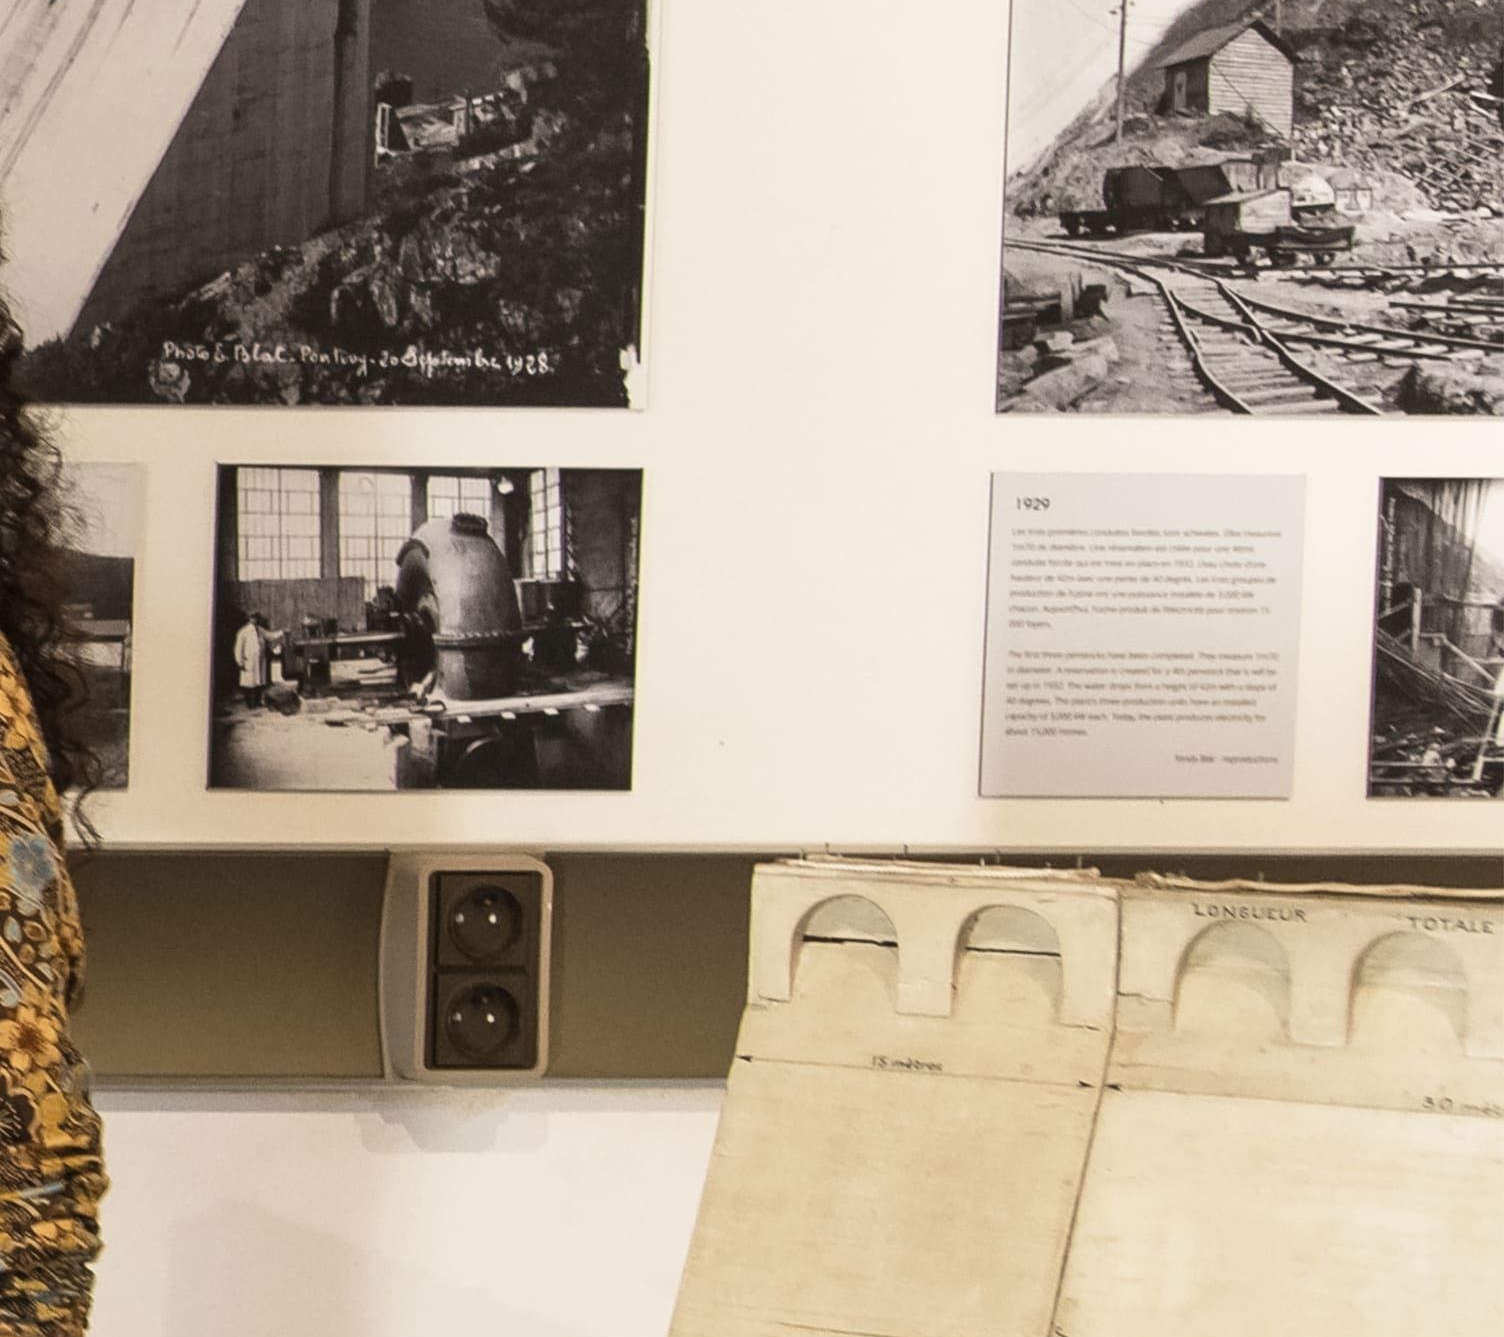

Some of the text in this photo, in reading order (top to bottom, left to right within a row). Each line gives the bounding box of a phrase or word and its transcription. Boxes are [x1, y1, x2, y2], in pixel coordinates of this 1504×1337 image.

[163, 341, 210, 360] Photo
[1016, 497, 1050, 511] 1929
[1407, 916, 1494, 934] TOTALE
